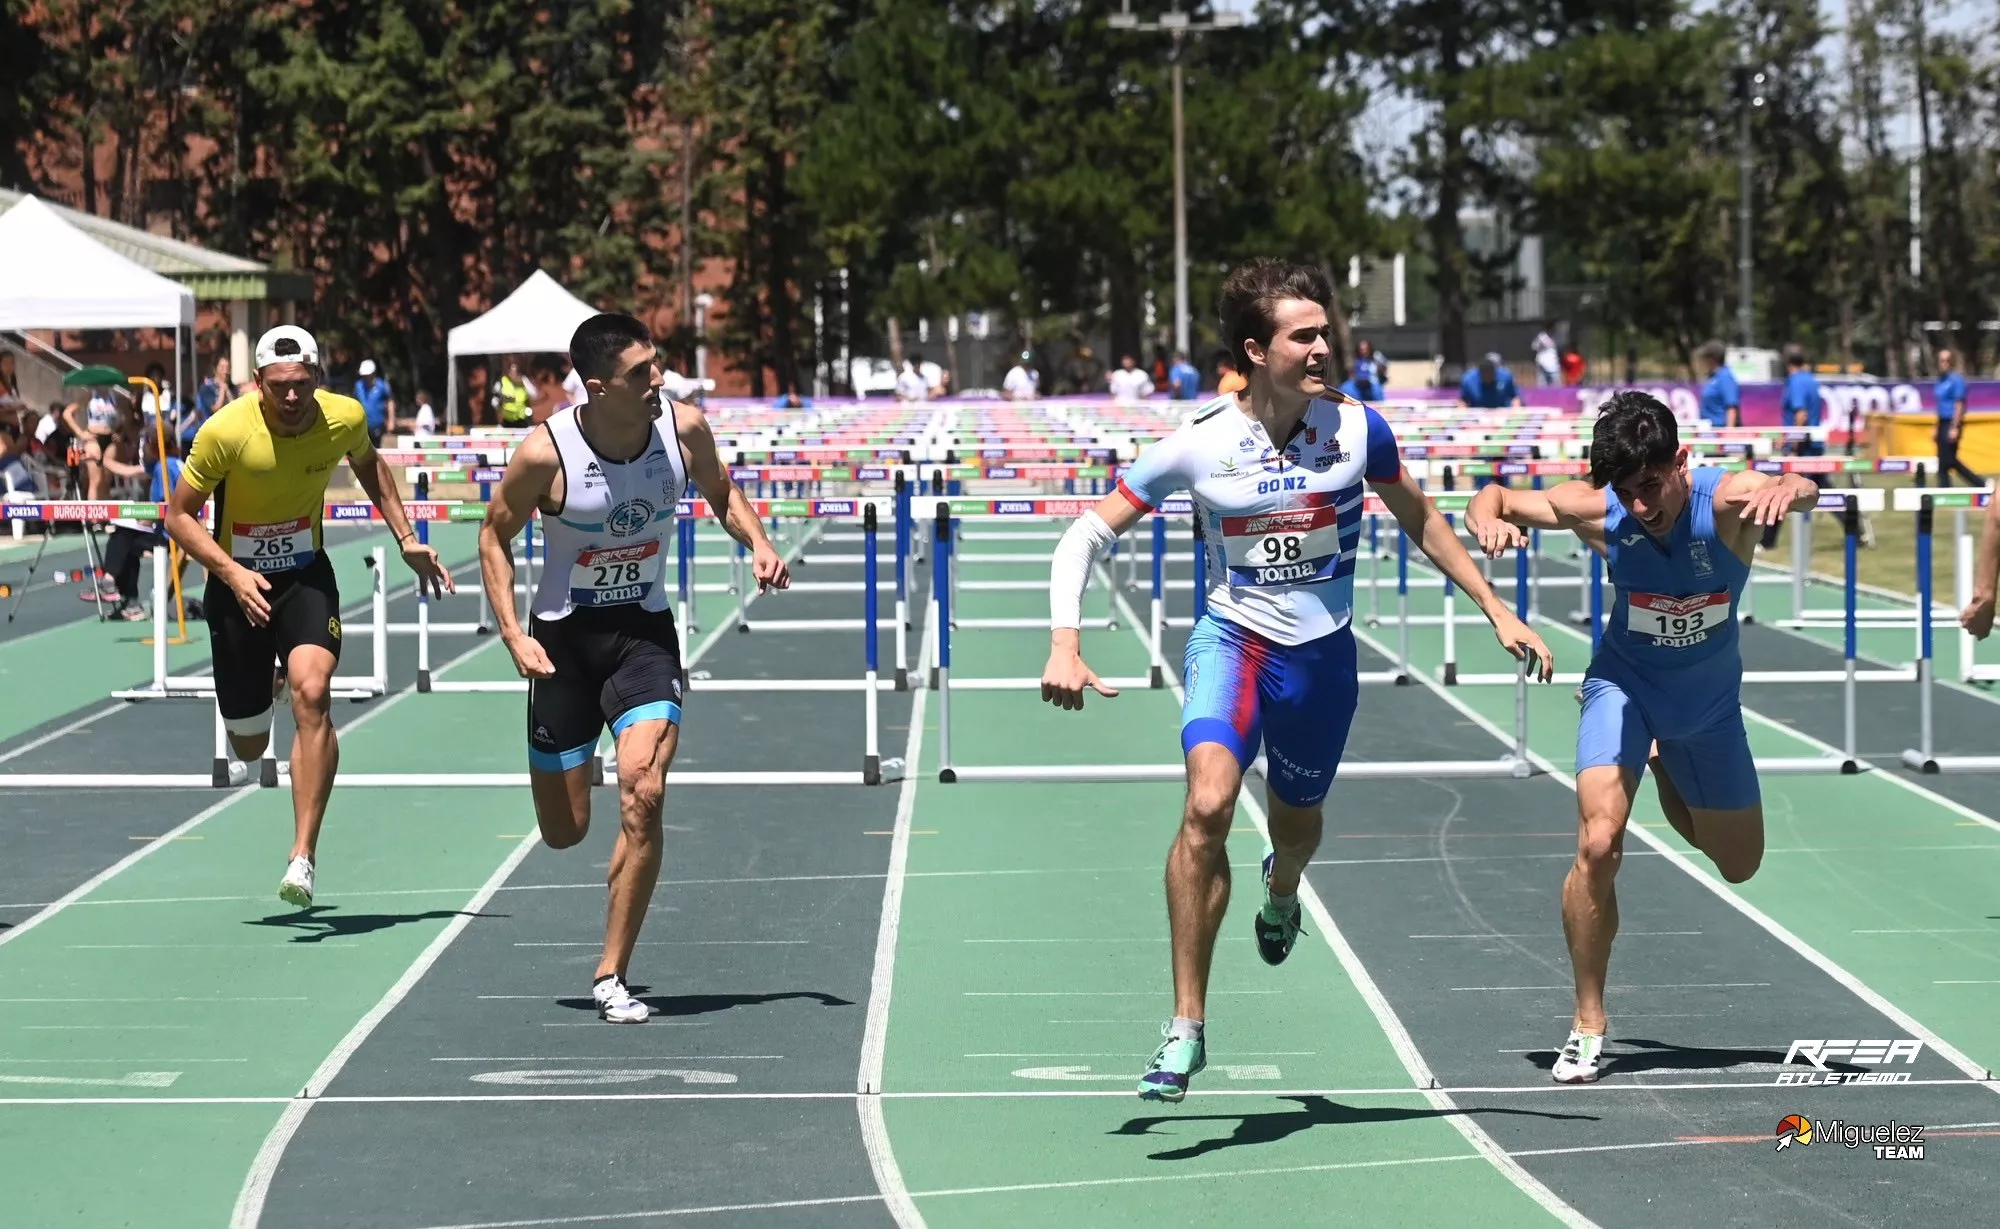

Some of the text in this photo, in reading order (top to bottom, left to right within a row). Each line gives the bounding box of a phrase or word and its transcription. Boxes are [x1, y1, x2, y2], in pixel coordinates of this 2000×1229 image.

[54, 507, 86, 519] BURGOS
[88, 507, 109, 519] 2024
[416, 506, 438, 519] 2024
[1270, 513, 1315, 526] RFEA
[253, 536, 294, 557] 265
[1263, 536, 1302, 563] 98
[593, 562, 640, 587] 278
[1655, 612, 1704, 635] 193
